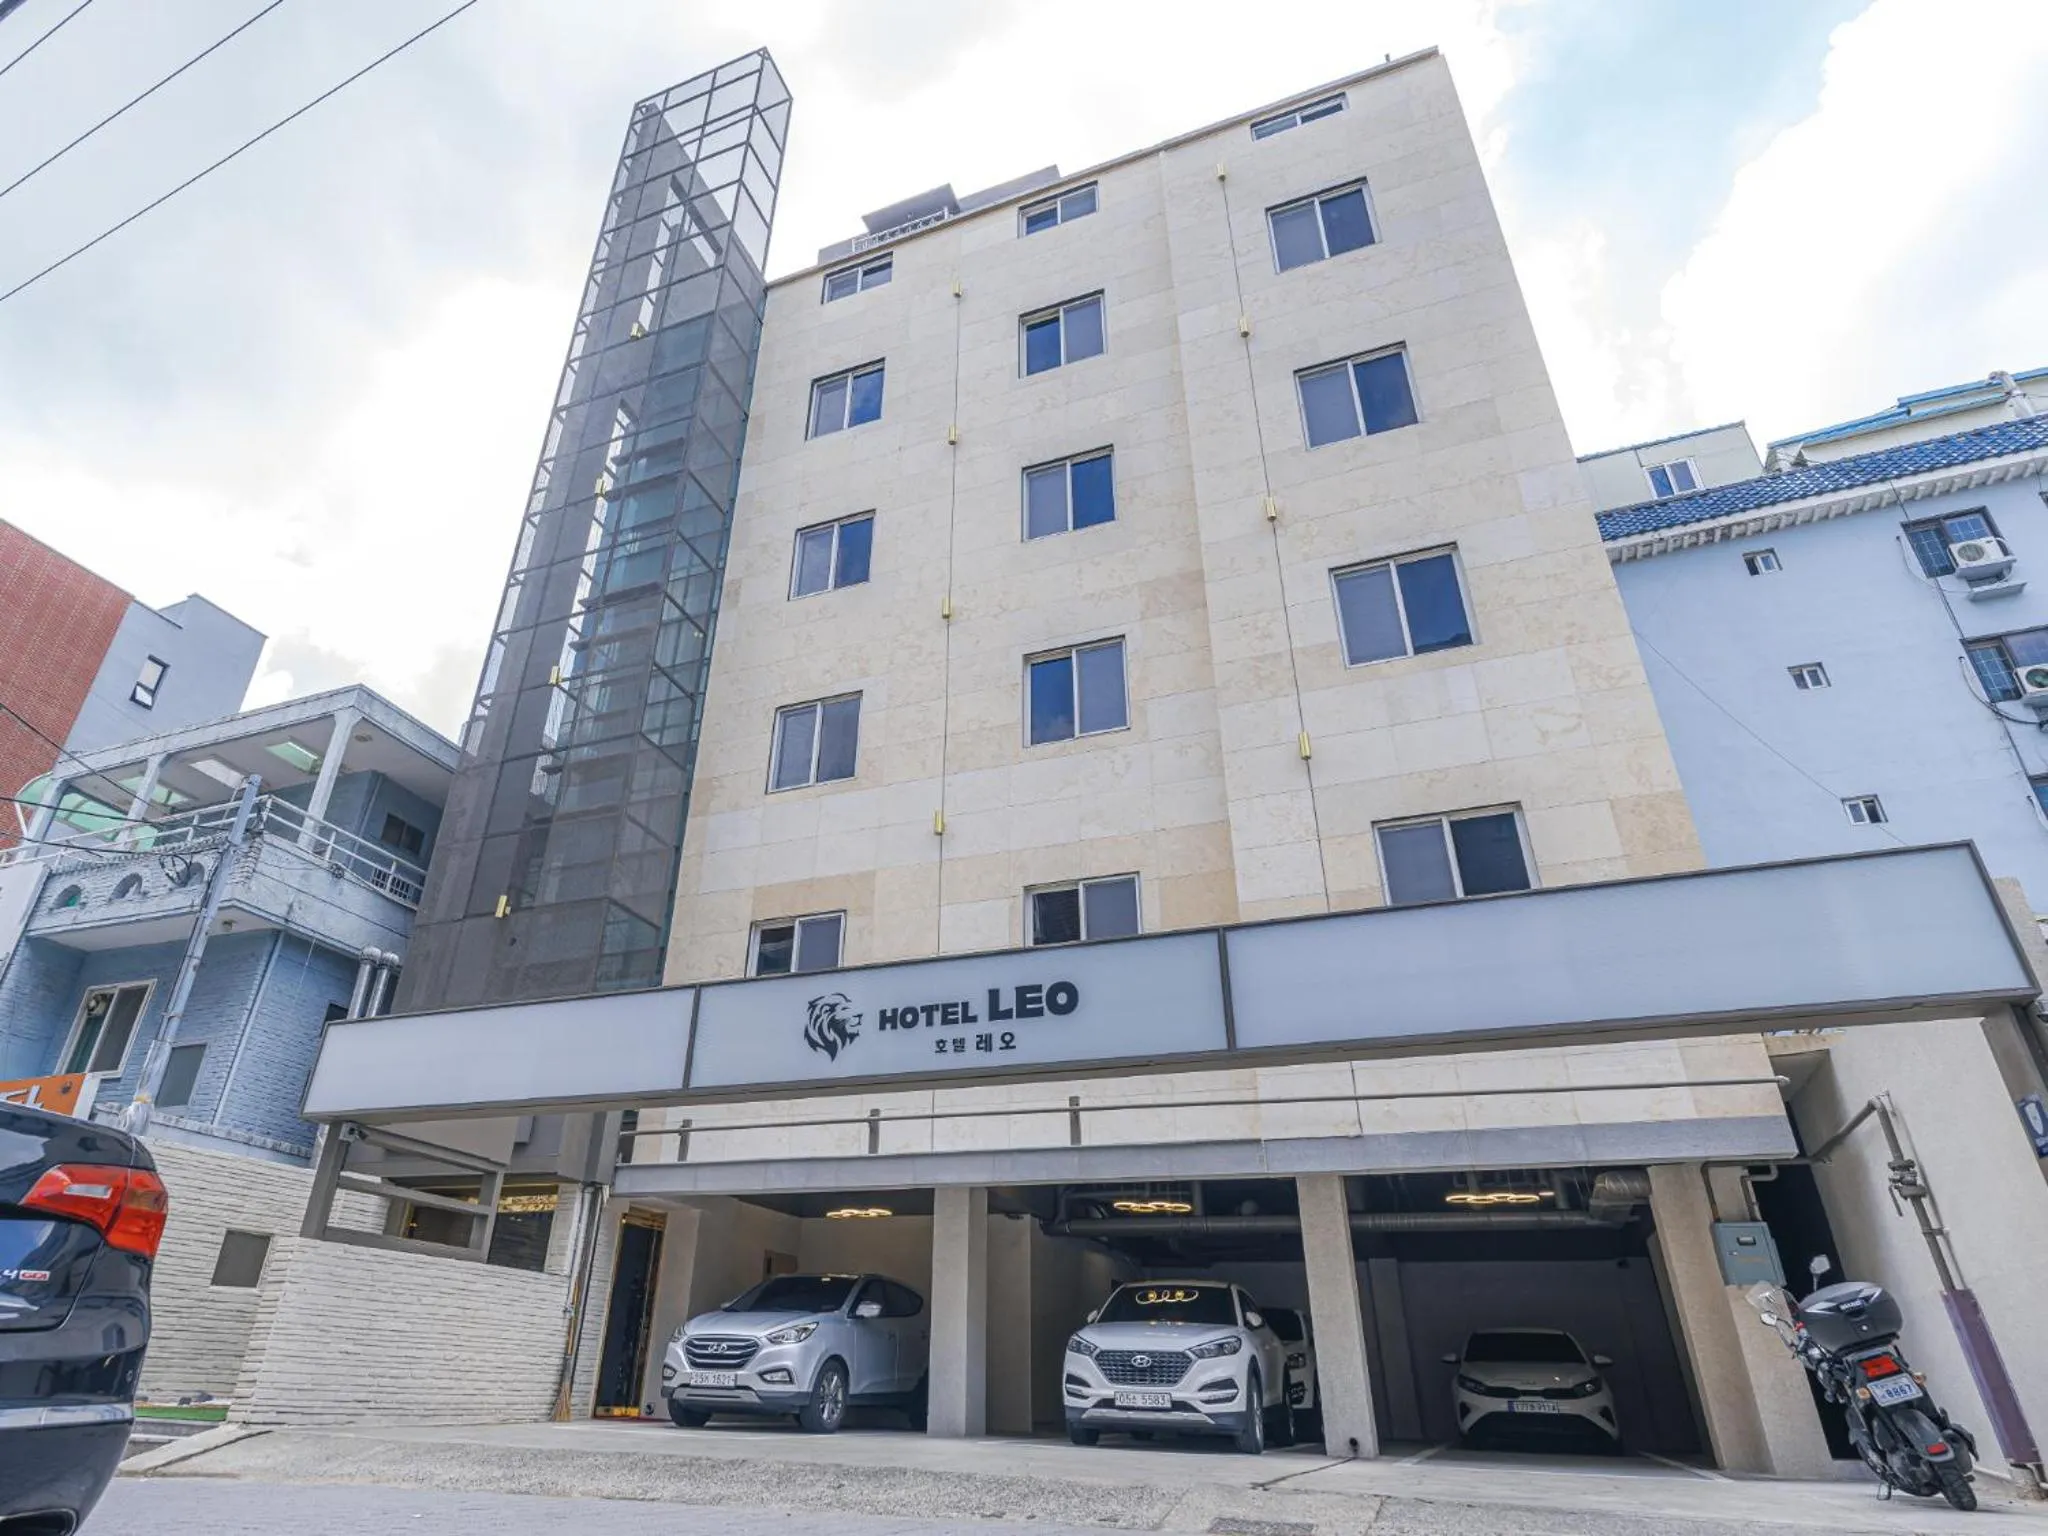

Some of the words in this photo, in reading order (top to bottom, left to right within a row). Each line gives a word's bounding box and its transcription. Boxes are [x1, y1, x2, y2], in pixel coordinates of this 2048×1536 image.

[879, 1001, 978, 1031] HOTEL
[988, 981, 1080, 1021] LEO
[935, 1037, 966, 1053] 호텔
[976, 1031, 1017, 1052] 레오
